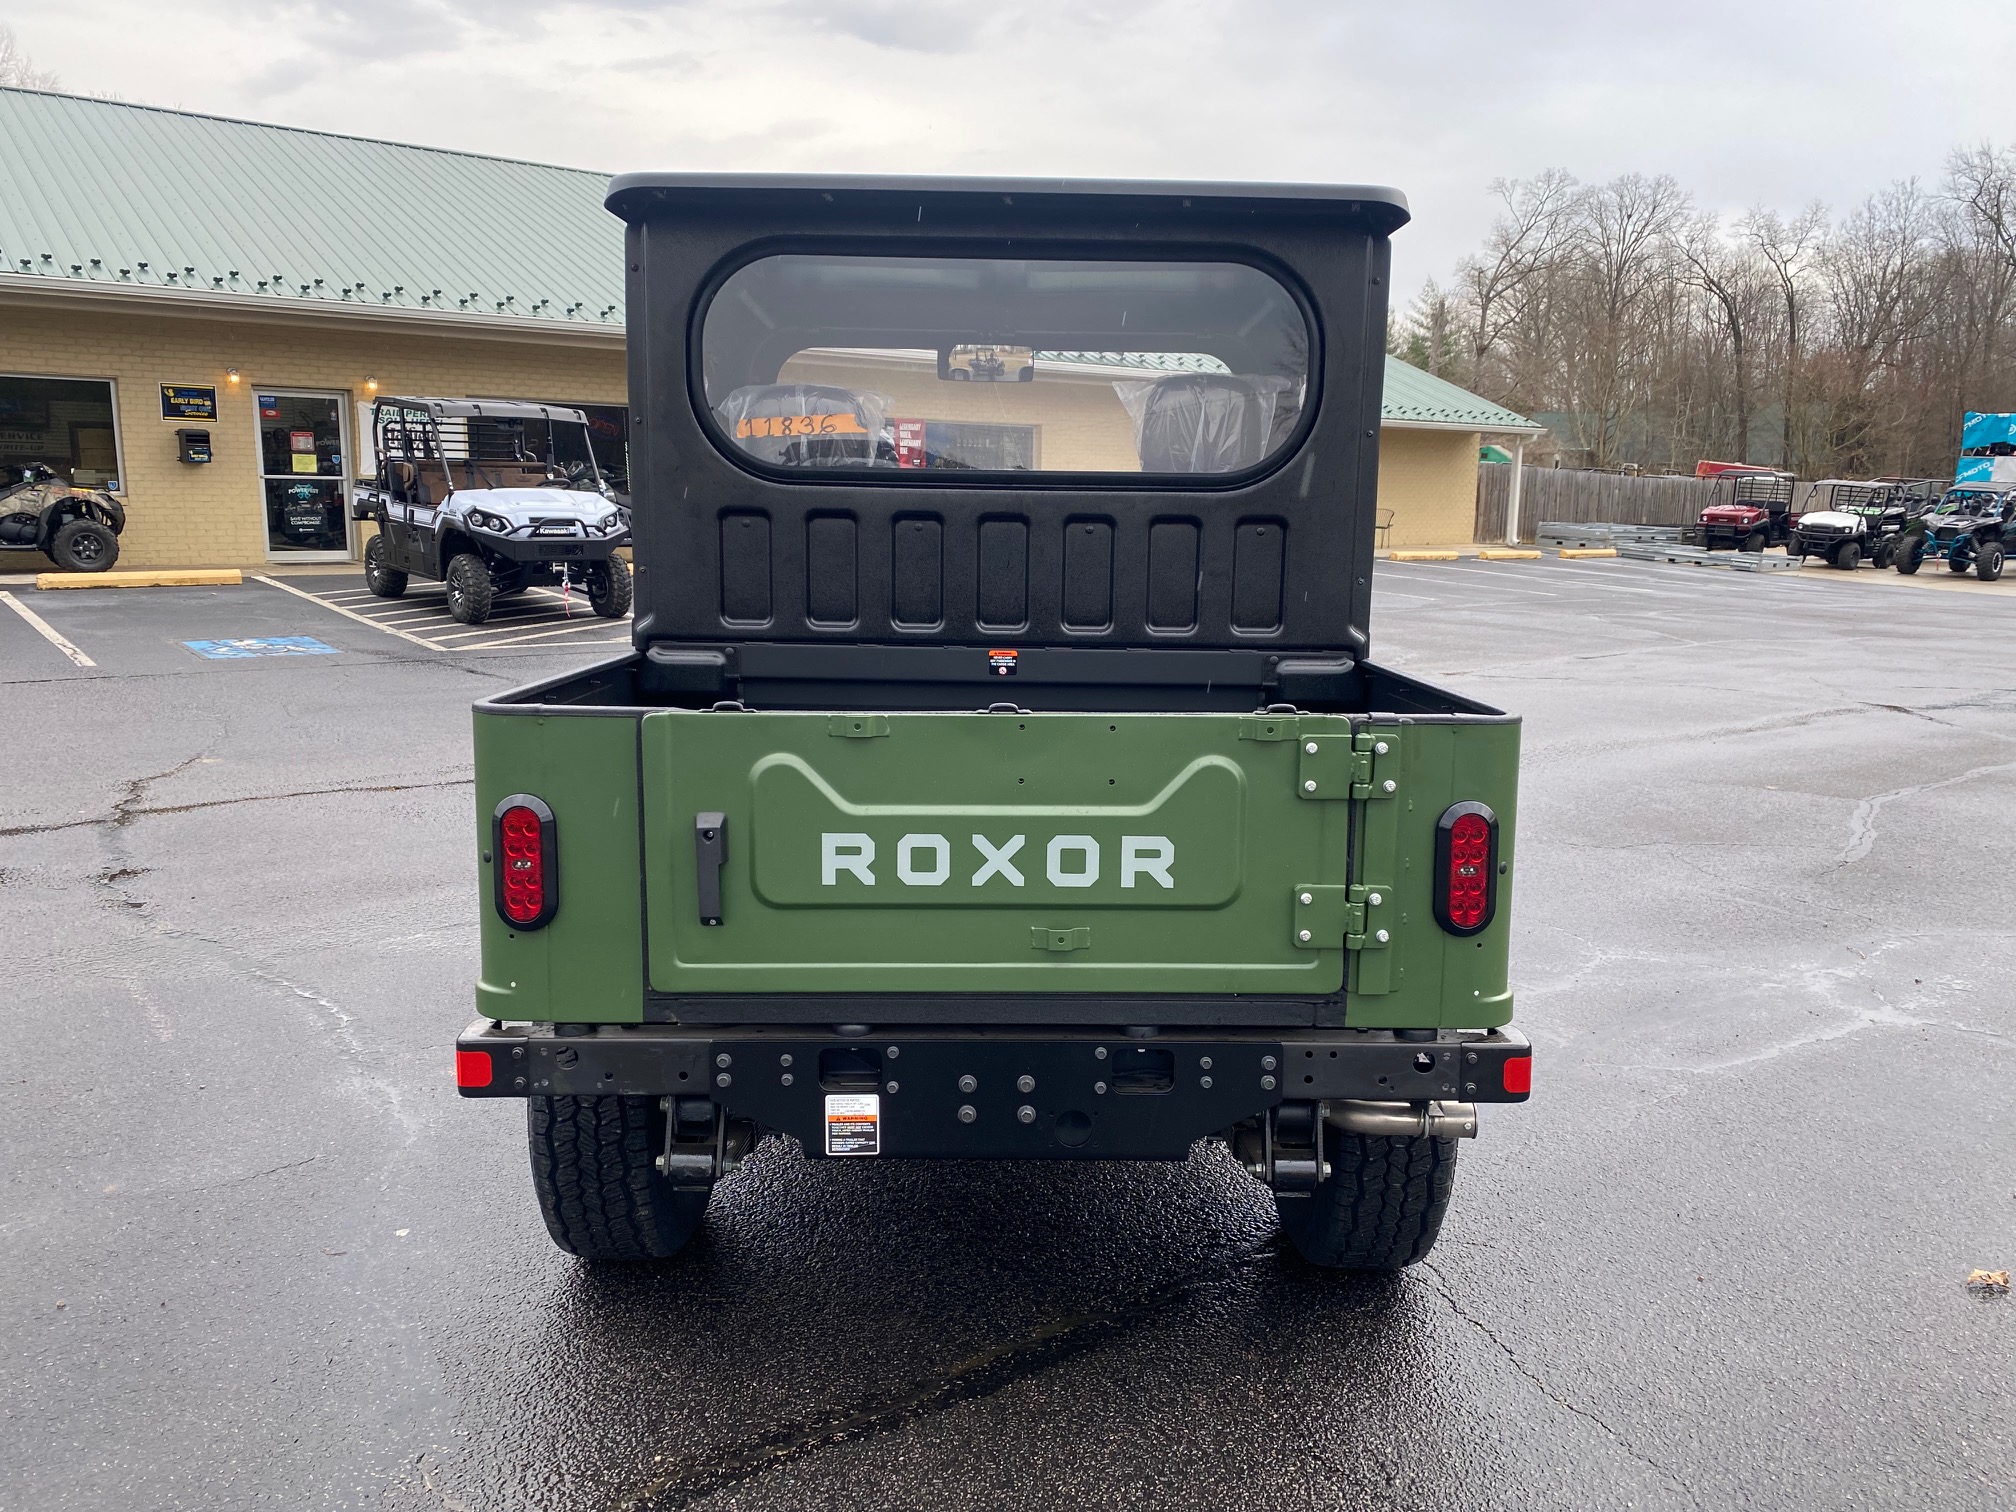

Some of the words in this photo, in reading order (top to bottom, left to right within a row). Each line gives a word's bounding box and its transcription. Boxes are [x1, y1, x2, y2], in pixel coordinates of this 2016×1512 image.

[744, 413, 838, 438] 11836
[0, 431, 43, 441] ERVICE
[540, 527, 570, 535] Kawasaki
[821, 832, 1175, 889] ROXOR
